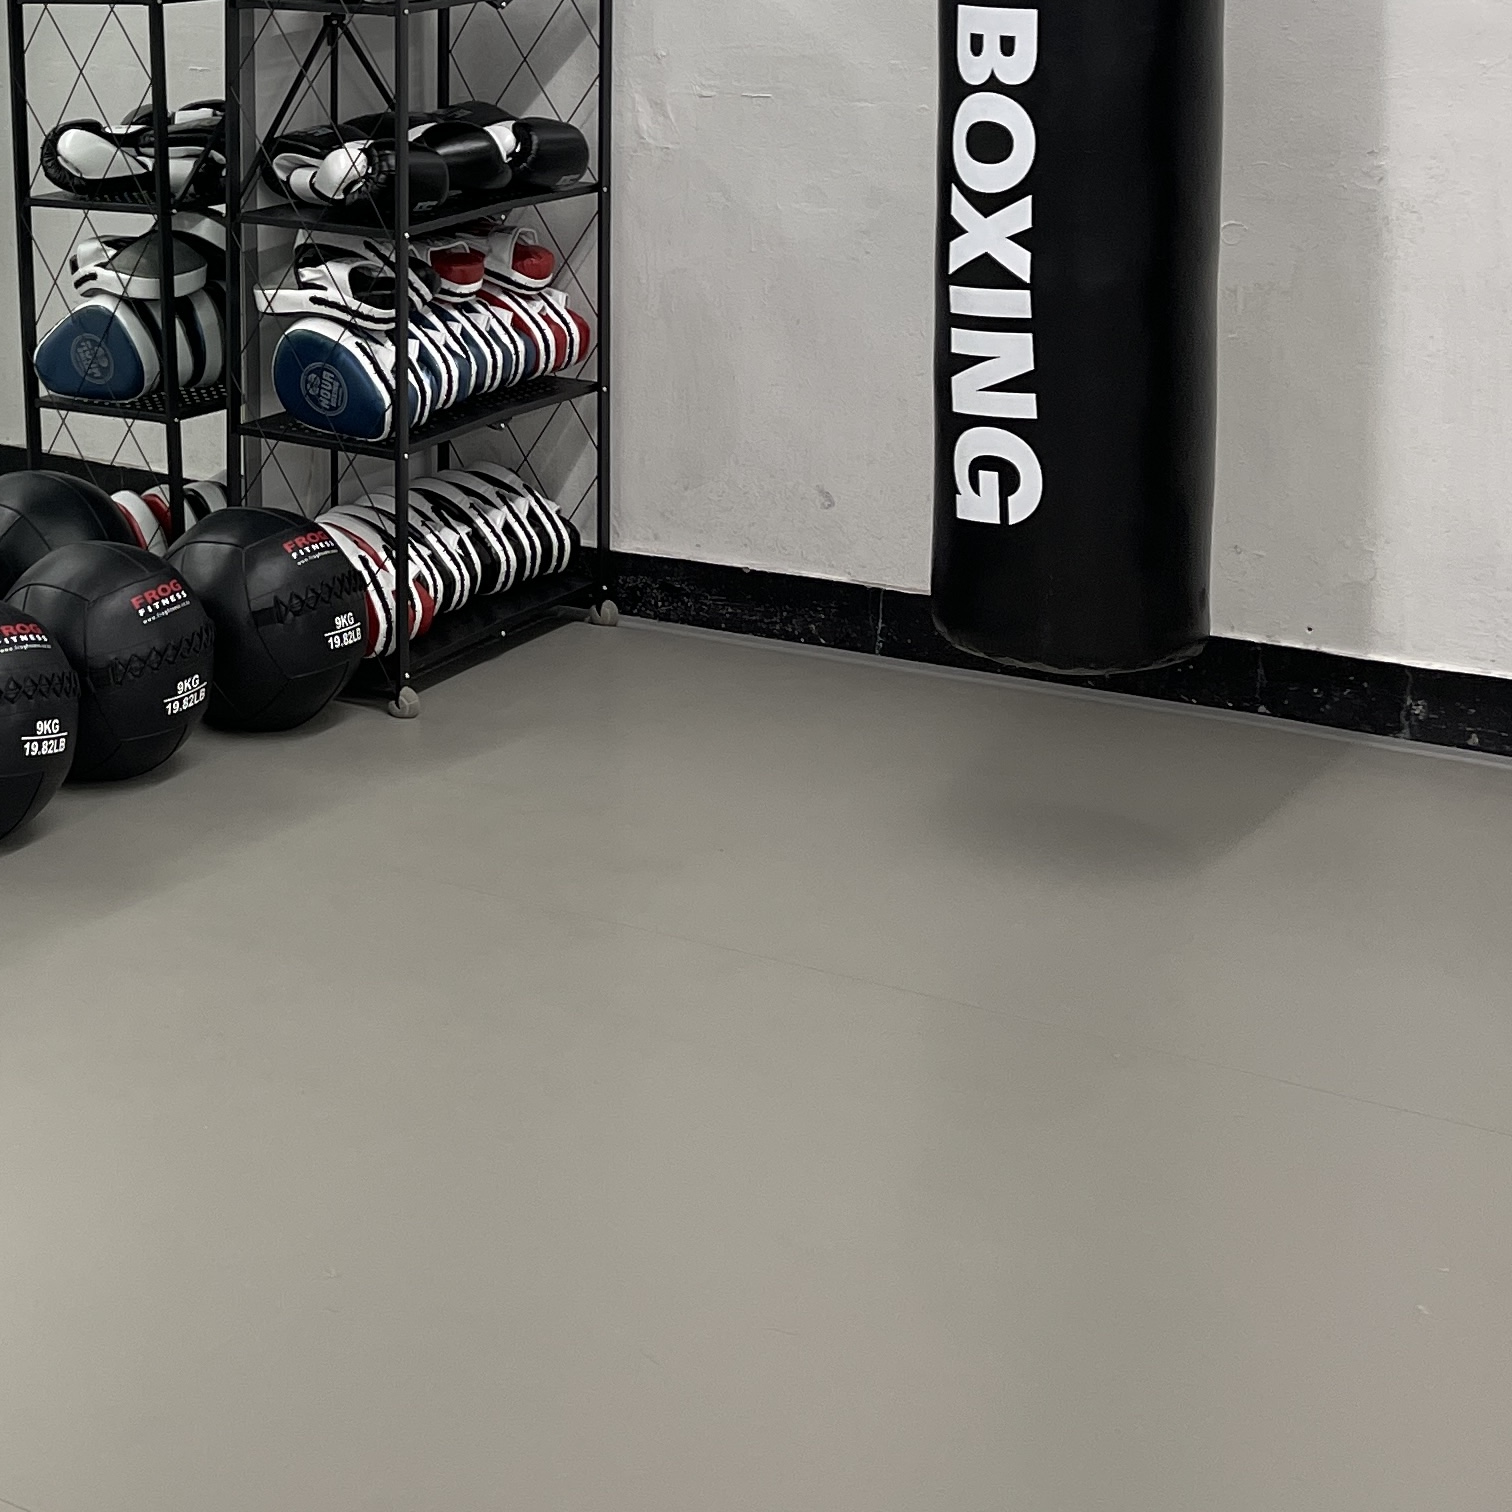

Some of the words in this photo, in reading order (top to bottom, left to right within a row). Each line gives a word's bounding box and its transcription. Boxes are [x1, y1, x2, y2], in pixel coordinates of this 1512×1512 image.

[949, 5, 1042, 525] BOXING
[130, 579, 182, 610] FROG
[138, 590, 187, 617] FITNESS
[334, 612, 355, 629] 9KG
[328, 627, 362, 650] 19.82LB
[177, 674, 200, 695] 9KG
[165, 687, 206, 715] 19.82LB
[36, 718, 60, 735] 9KG
[23, 737, 66, 756] 19.82LB
